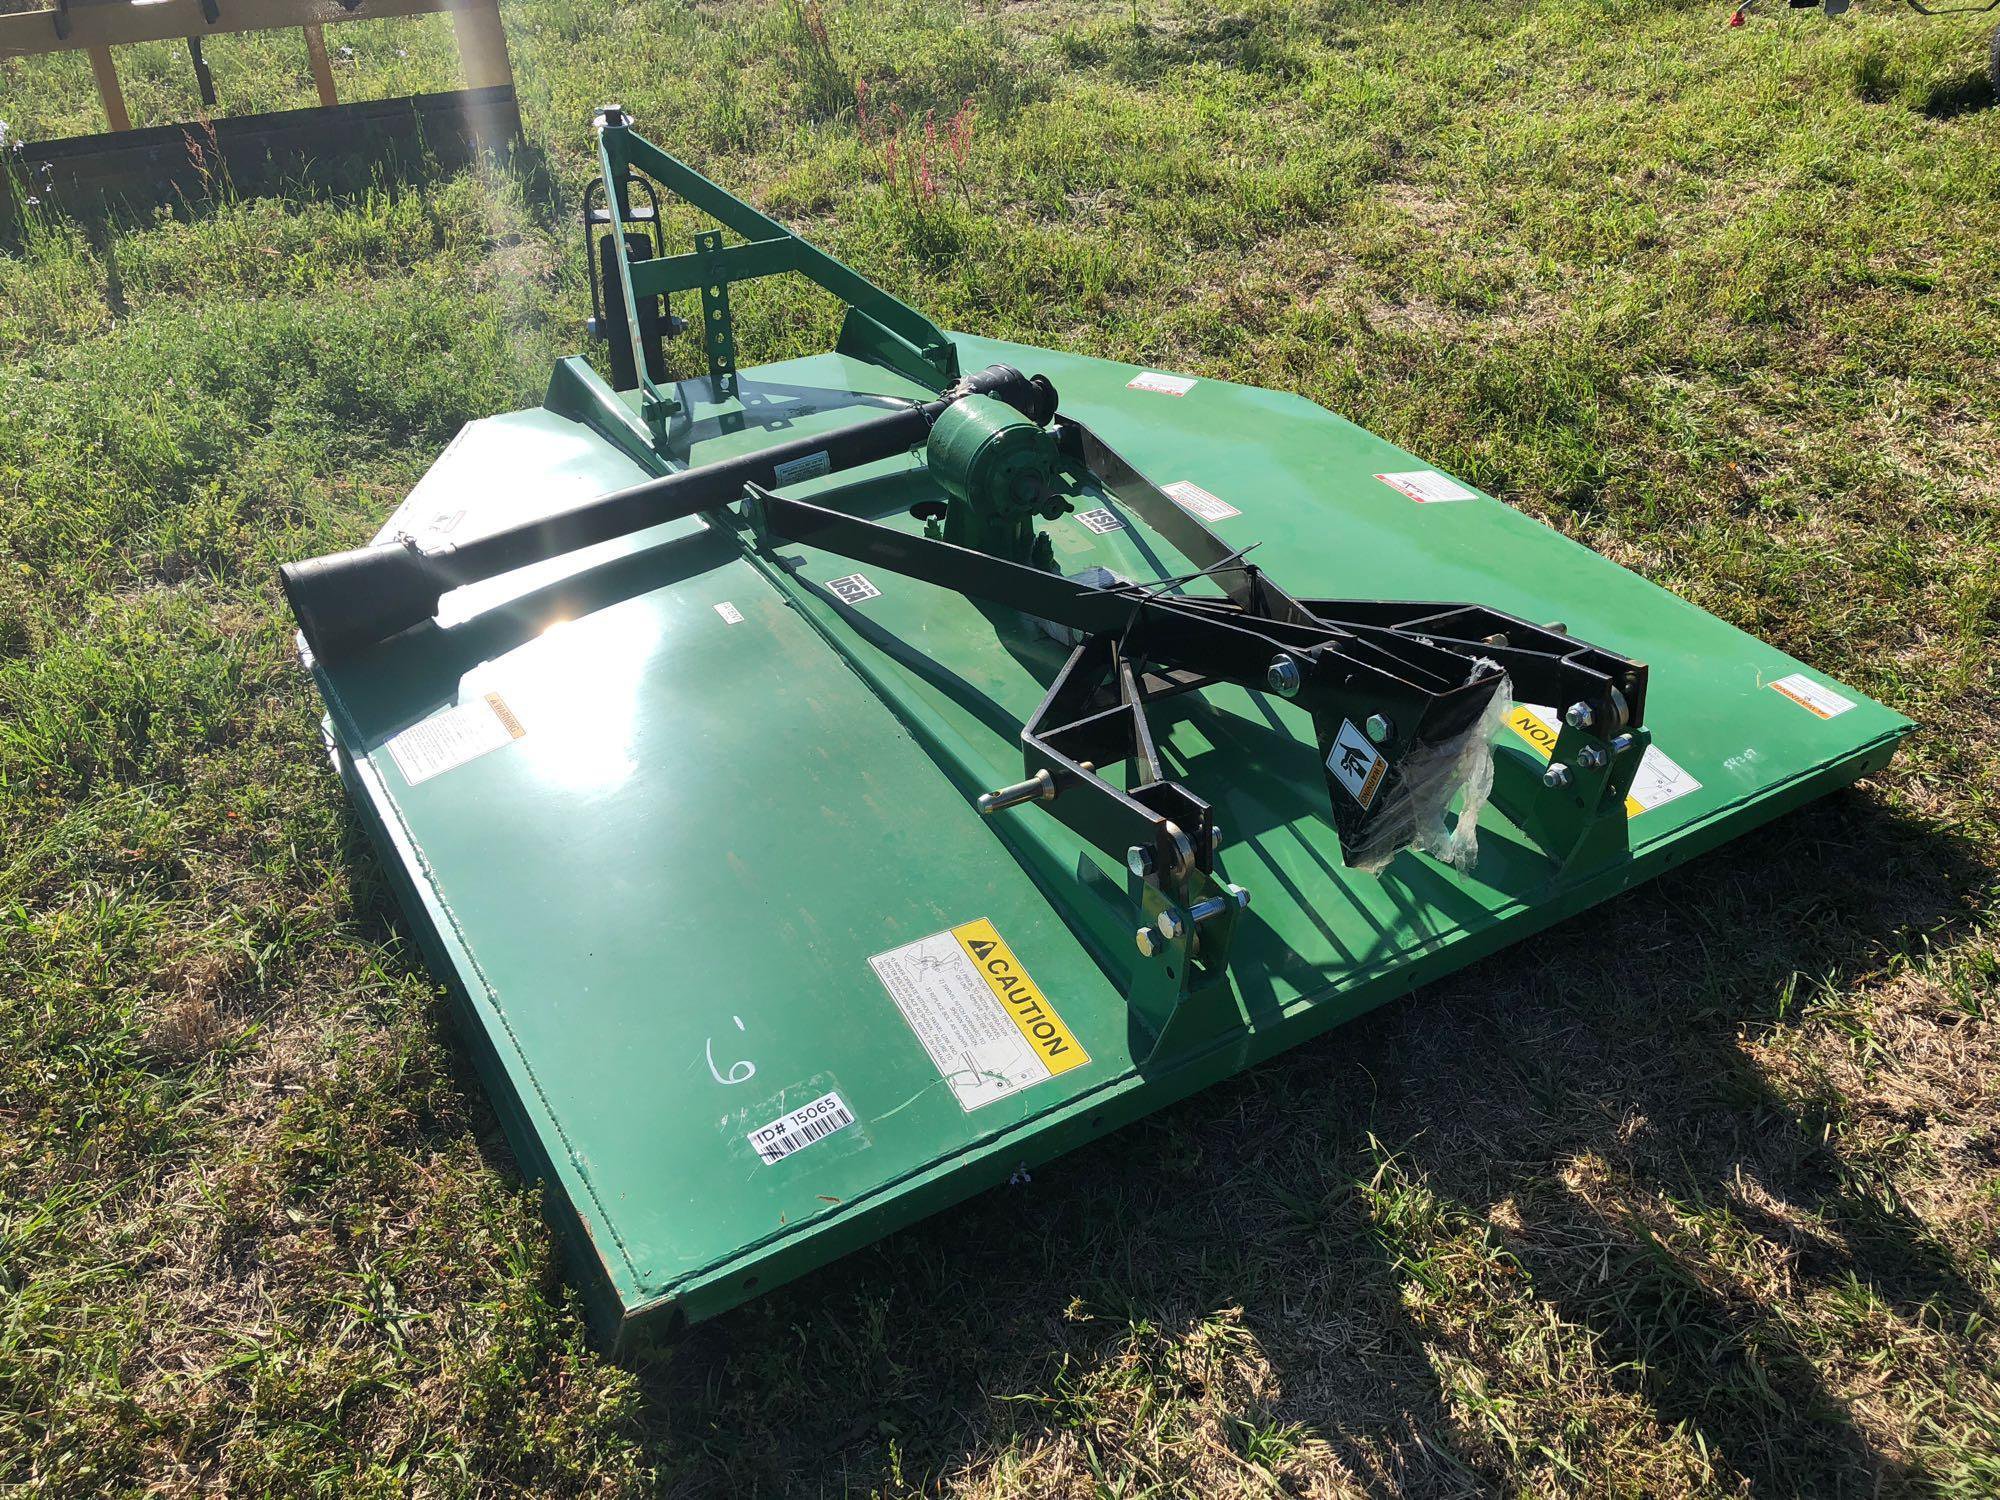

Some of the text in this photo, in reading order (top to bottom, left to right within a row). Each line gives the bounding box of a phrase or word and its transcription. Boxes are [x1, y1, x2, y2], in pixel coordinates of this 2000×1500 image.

[1085, 509, 1122, 531] USA
[829, 577, 868, 603] USA
[988, 959, 1069, 1057] CAUTION
[756, 1098, 836, 1145] ID# 15065
